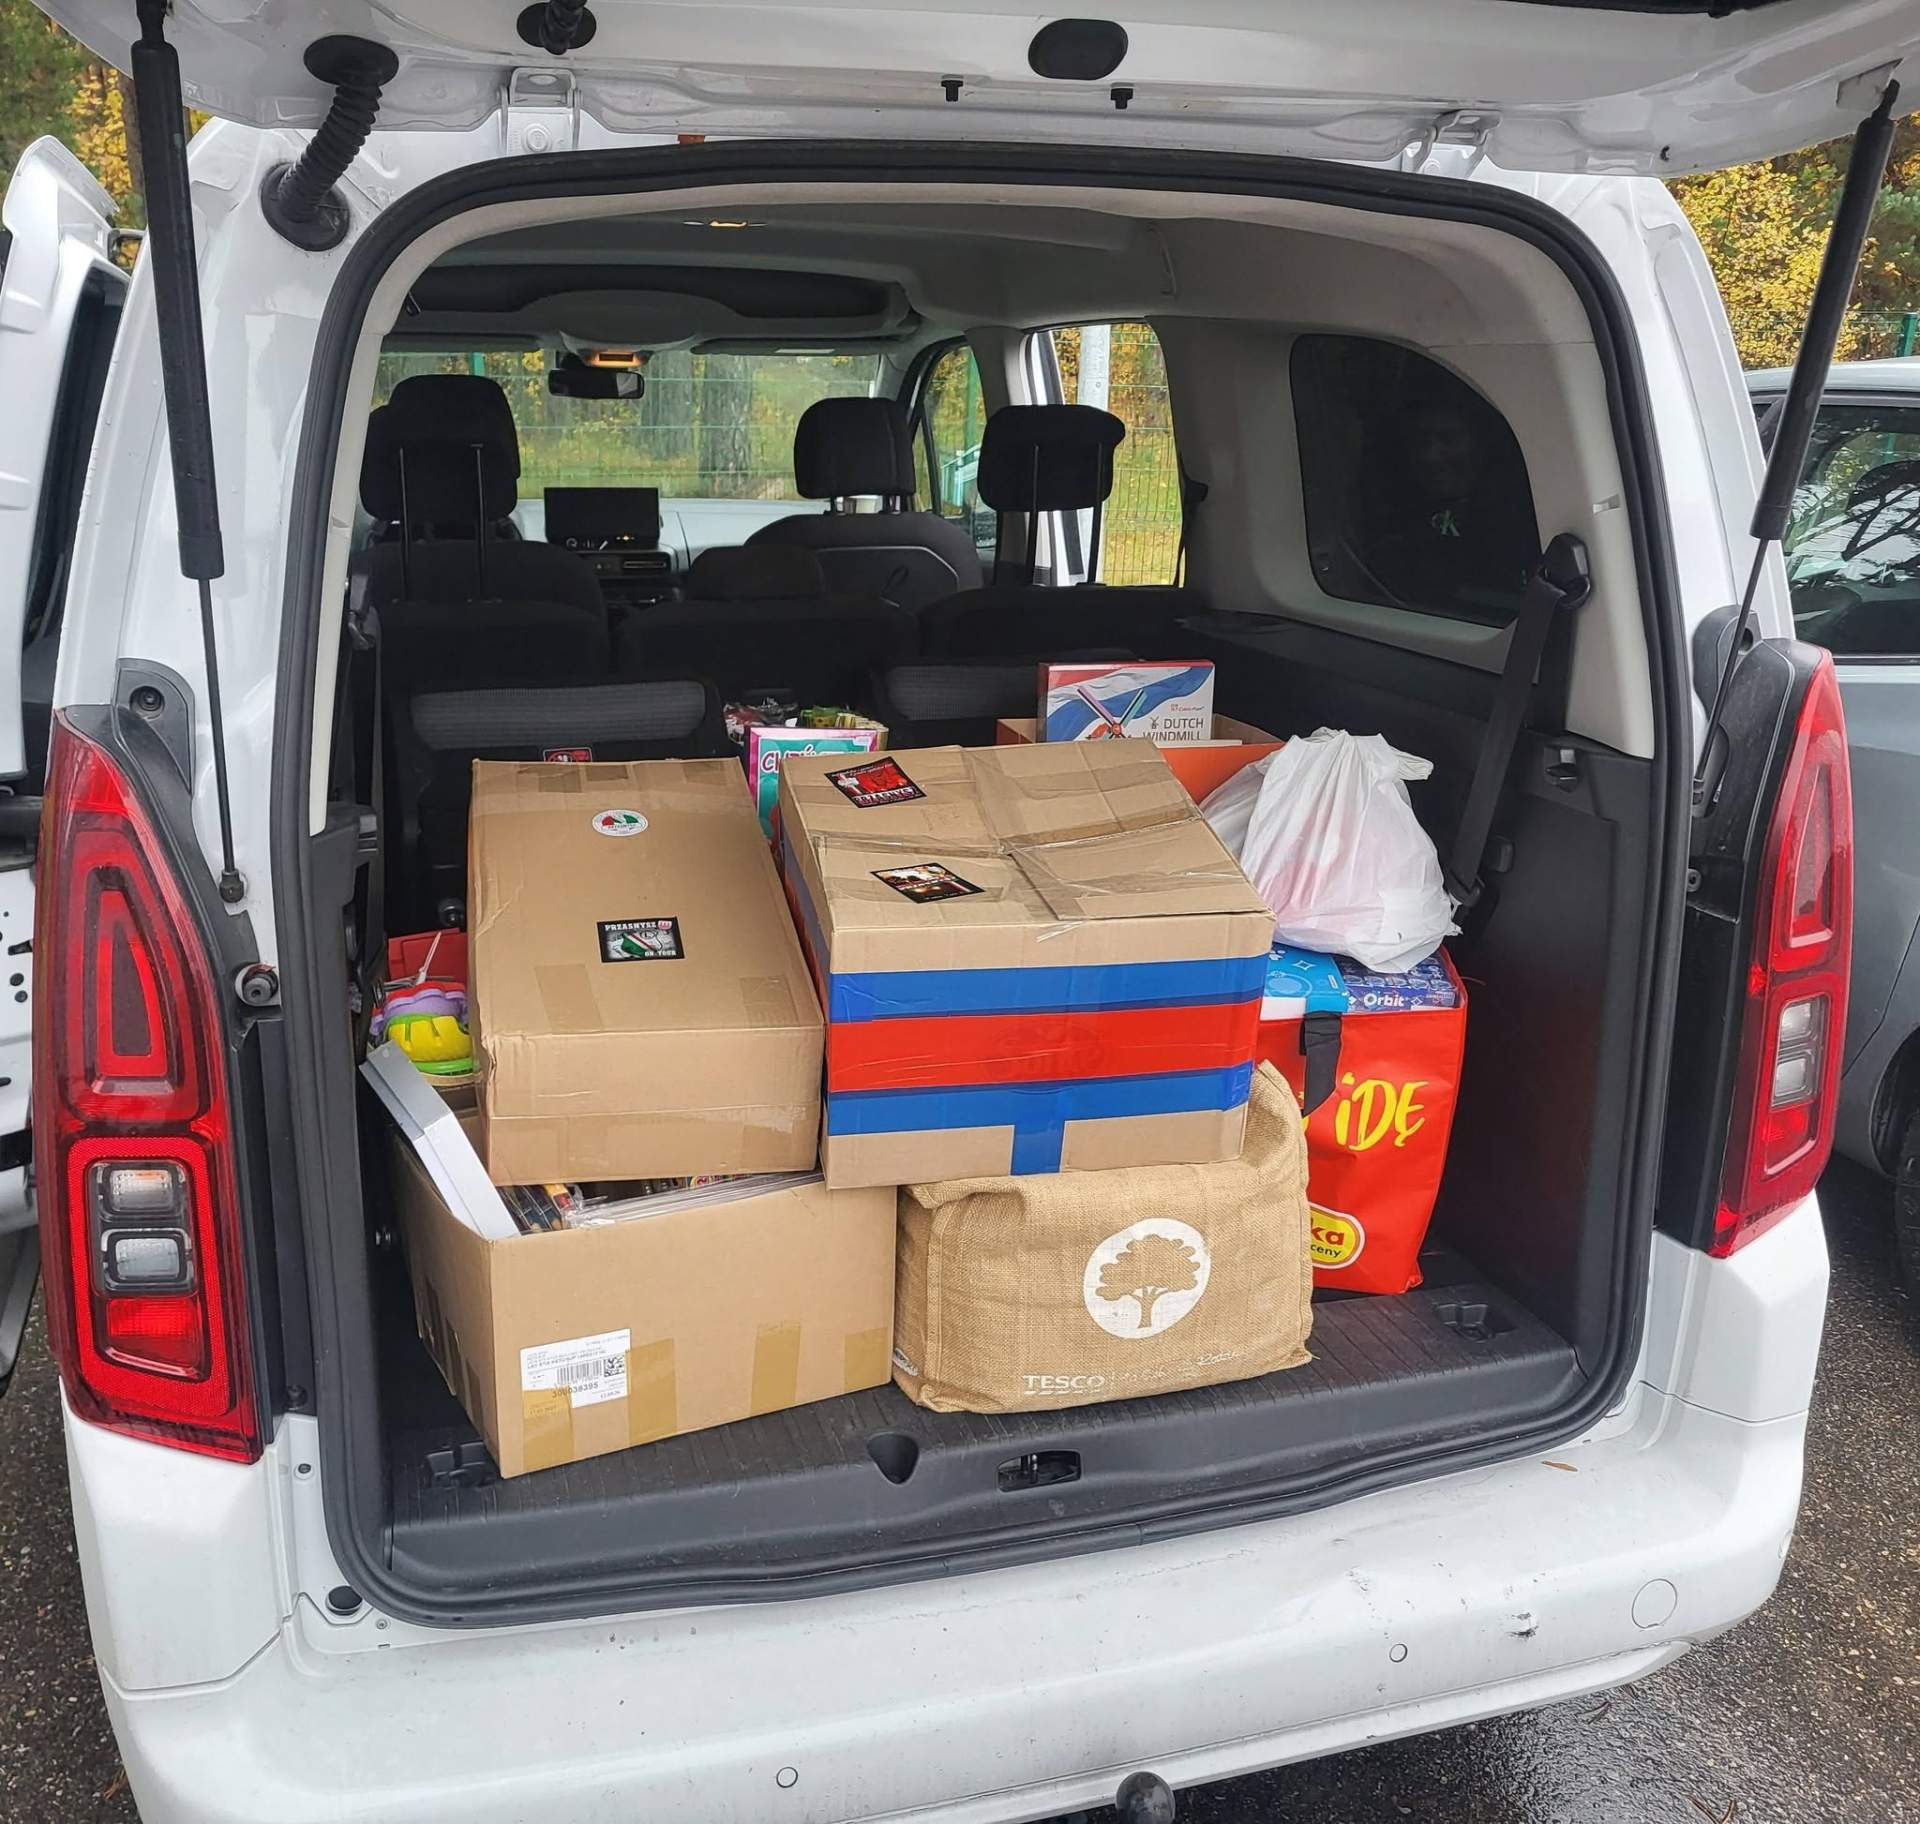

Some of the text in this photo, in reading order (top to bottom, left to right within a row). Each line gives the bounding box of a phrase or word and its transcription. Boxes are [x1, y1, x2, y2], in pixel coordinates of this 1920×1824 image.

[1163, 718, 1204, 729] DUTCH
[1143, 730, 1200, 741] WINDMILL
[604, 921, 657, 931] PRZASNYSZ
[1363, 993, 1405, 1007] Orbit
[1310, 1243, 1342, 1258] ceny
[1022, 1374, 1106, 1390] TESCO
